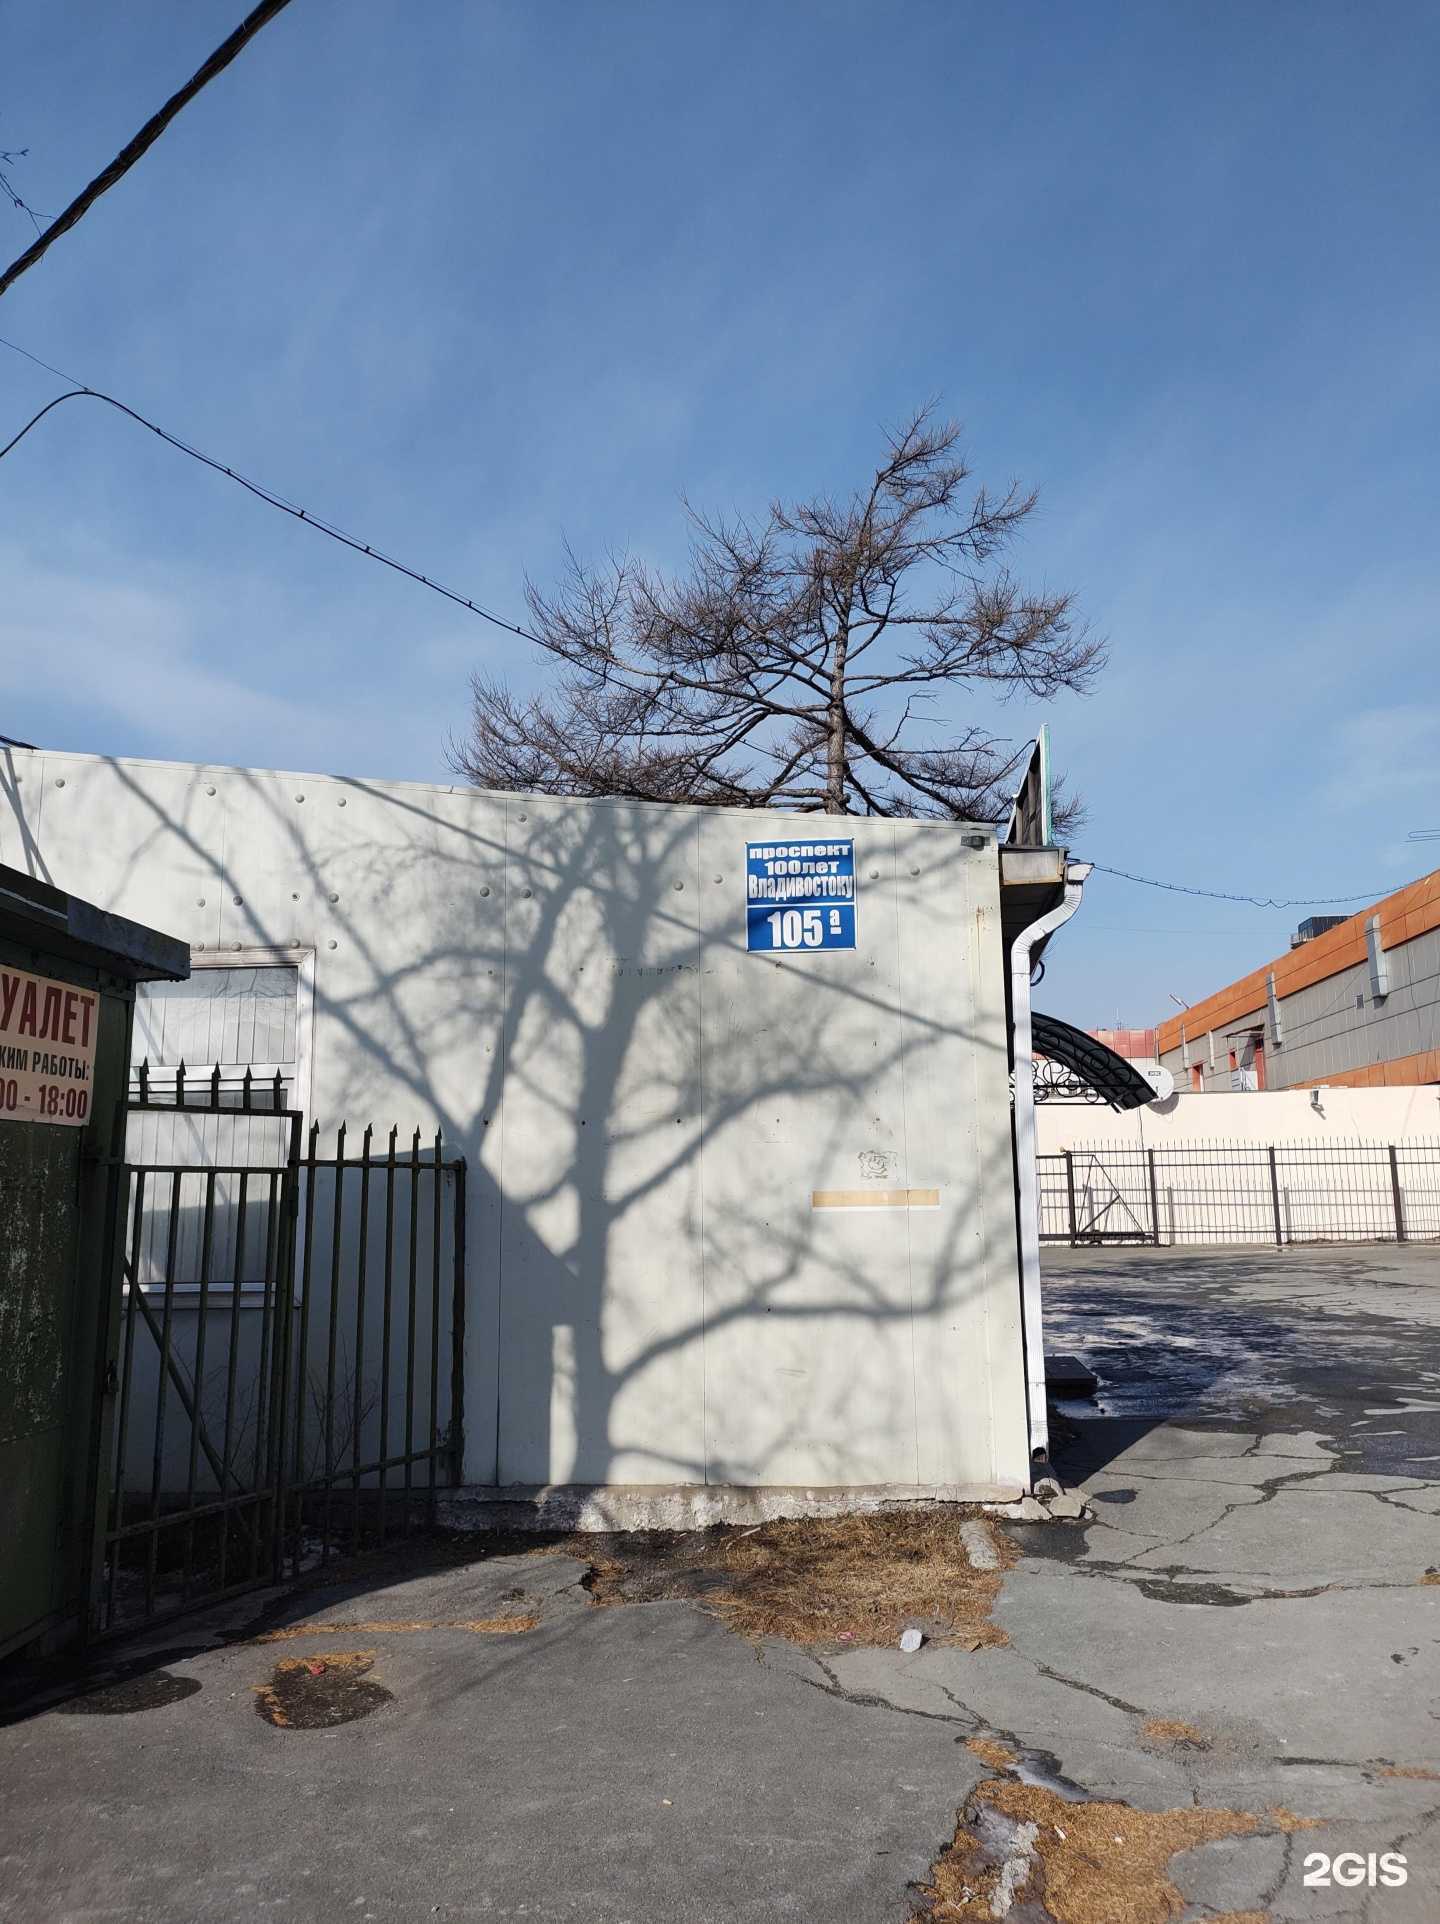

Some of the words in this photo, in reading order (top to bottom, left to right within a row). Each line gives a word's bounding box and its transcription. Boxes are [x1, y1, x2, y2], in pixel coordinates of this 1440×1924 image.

[749, 845, 851, 860] проспект
[748, 874, 853, 901] Владивостоку
[767, 910, 823, 948] 105
[32, 1051, 90, 1081] РАБОТЫ:
[38, 1083, 88, 1119] 18:00
